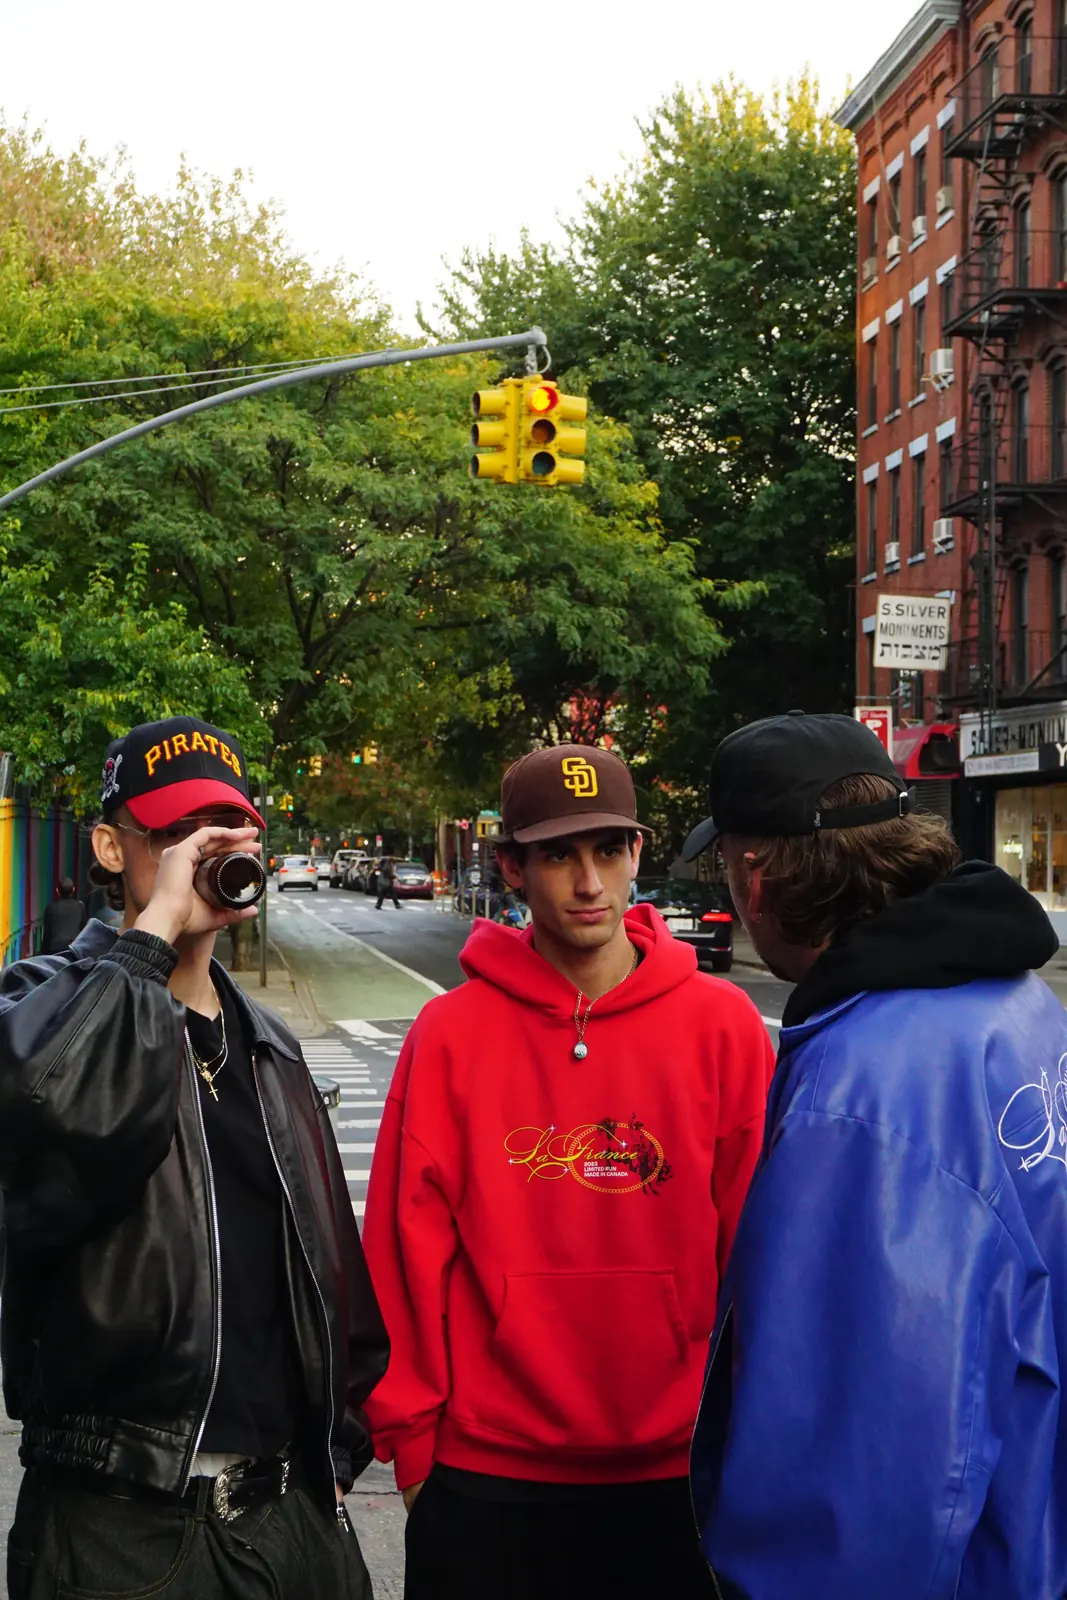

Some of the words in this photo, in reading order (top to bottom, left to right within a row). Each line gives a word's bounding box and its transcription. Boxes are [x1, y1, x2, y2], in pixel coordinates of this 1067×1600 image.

[880, 622, 946, 640] MONUMENTS
[144, 731, 242, 777] PIRATES
[561, 757, 598, 797] SD
[503, 1125, 567, 1182] La
[547, 1123, 638, 1161] France
